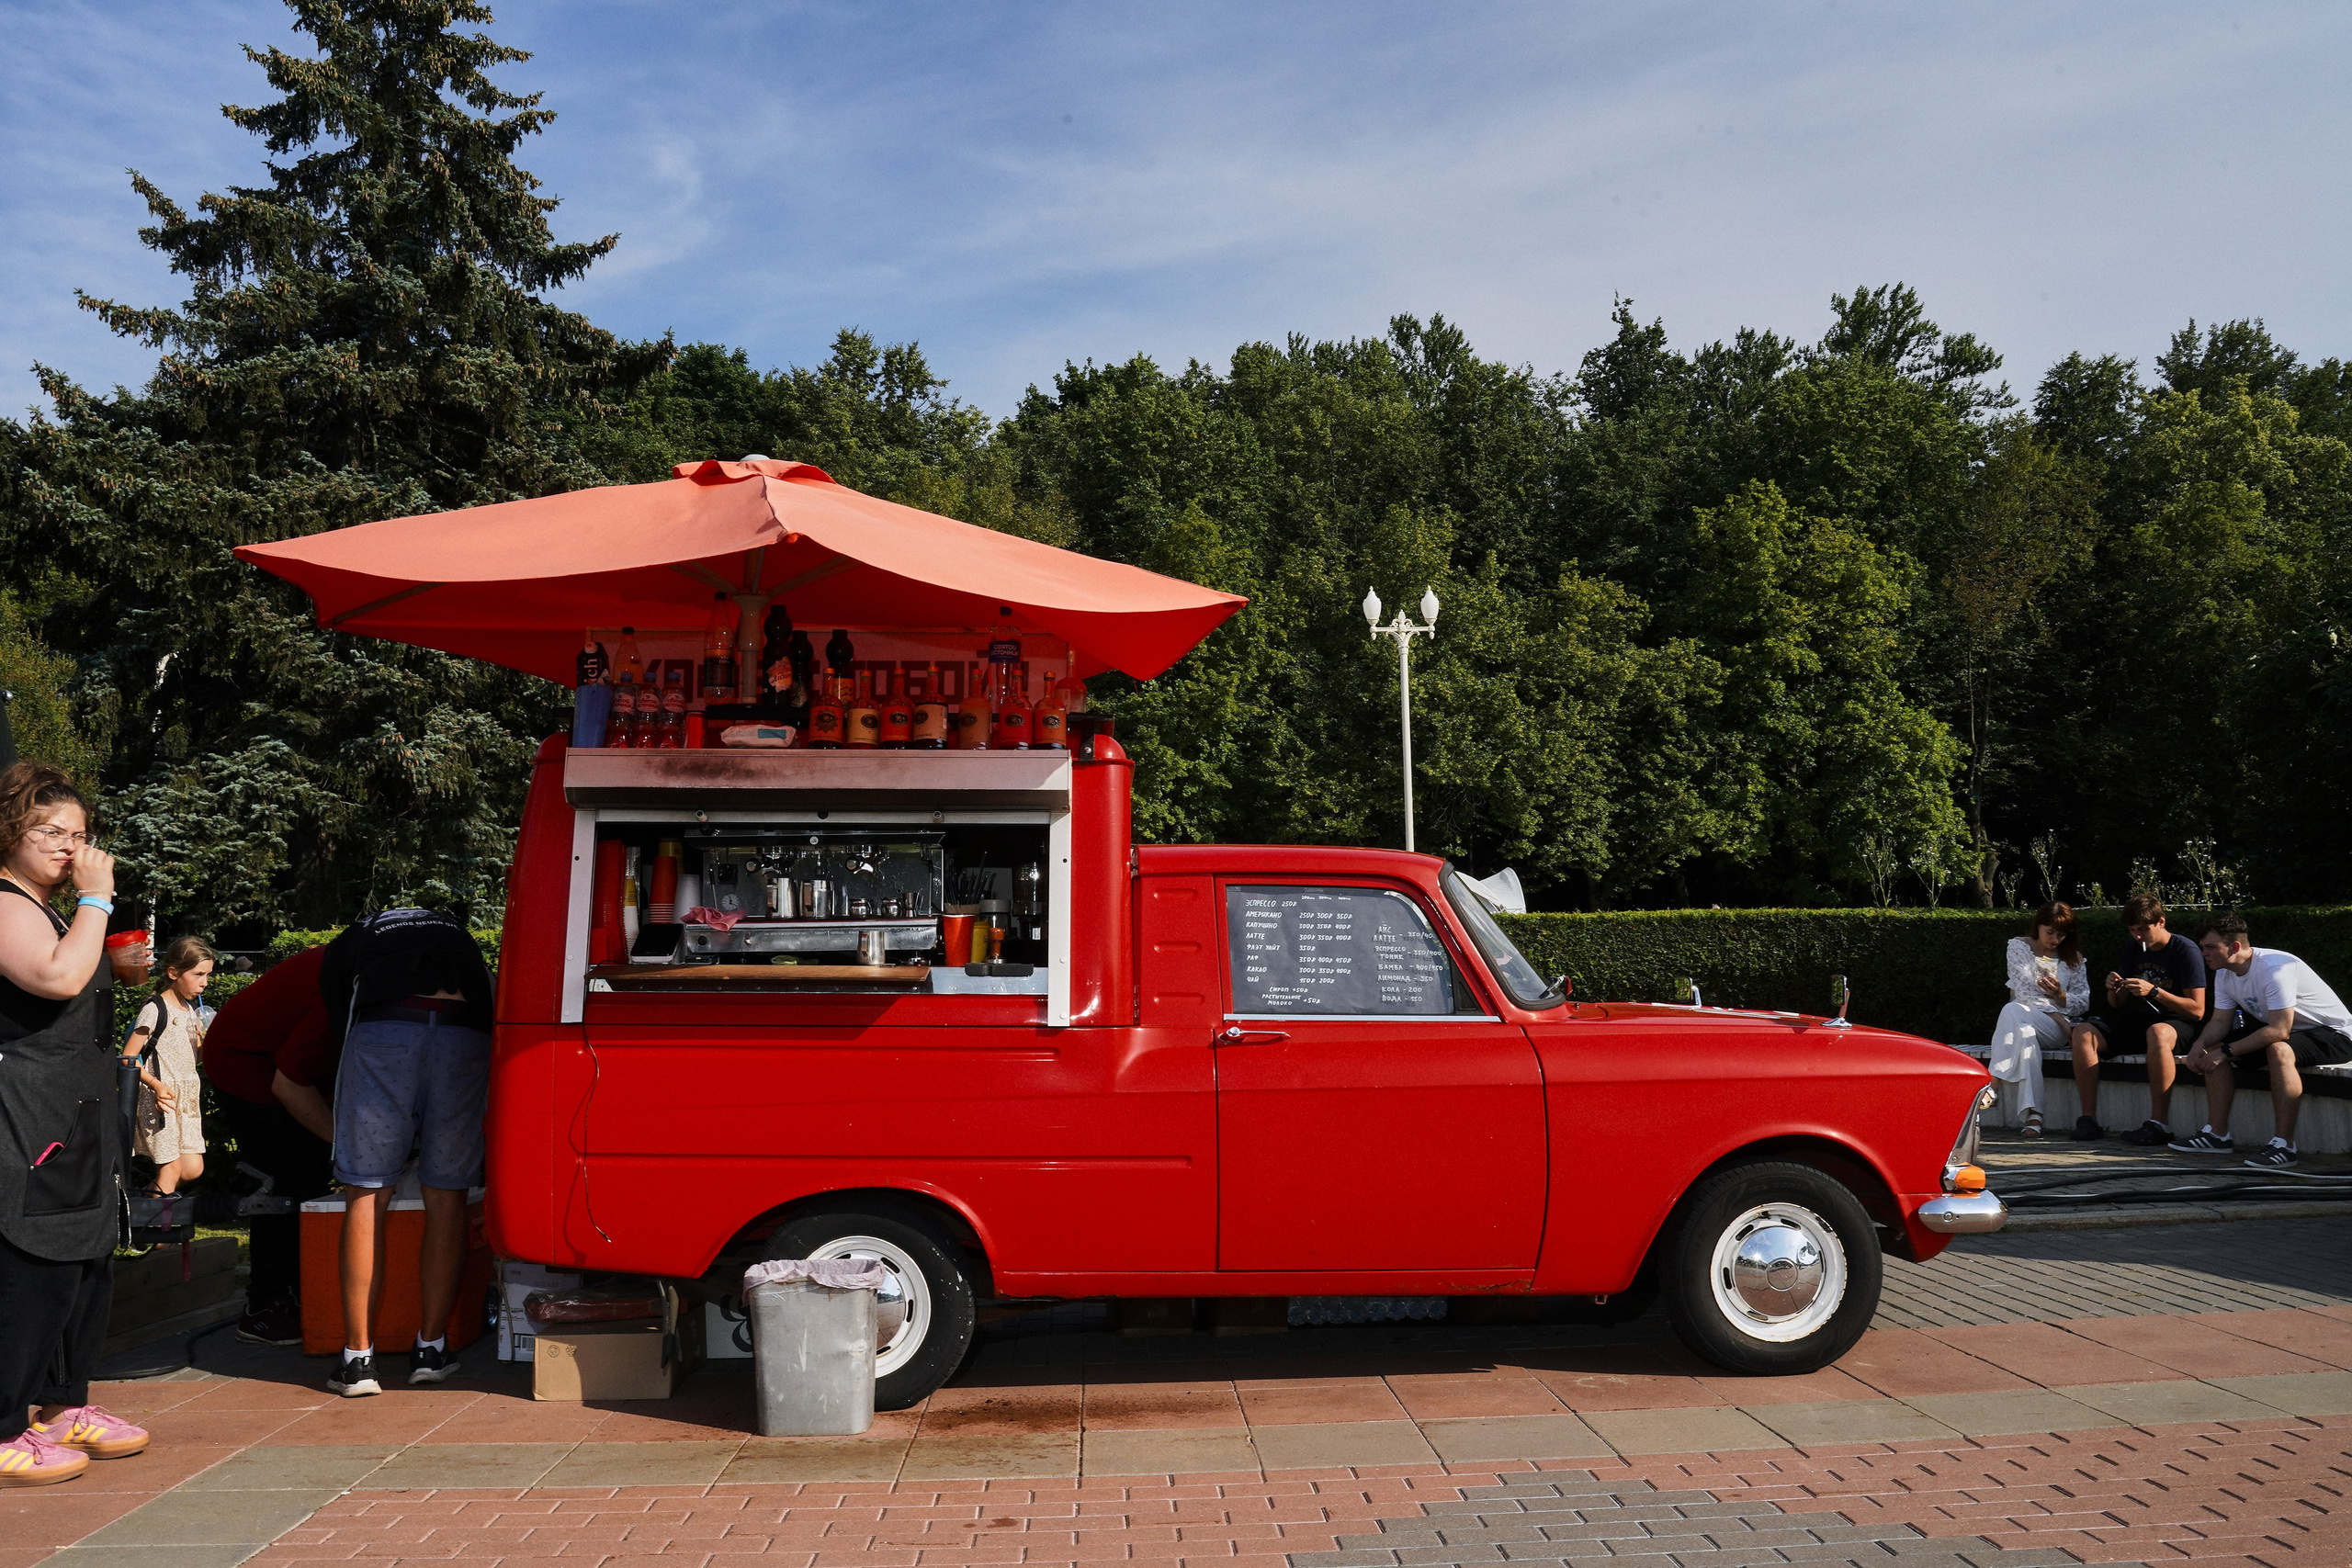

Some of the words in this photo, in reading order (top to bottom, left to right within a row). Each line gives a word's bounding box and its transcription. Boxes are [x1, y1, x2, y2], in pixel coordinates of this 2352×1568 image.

[375, 921, 414, 934] LEGENDS
[1378, 924, 1392, 933] АЙС
[1373, 934, 1396, 942] ЛАТТЕ
